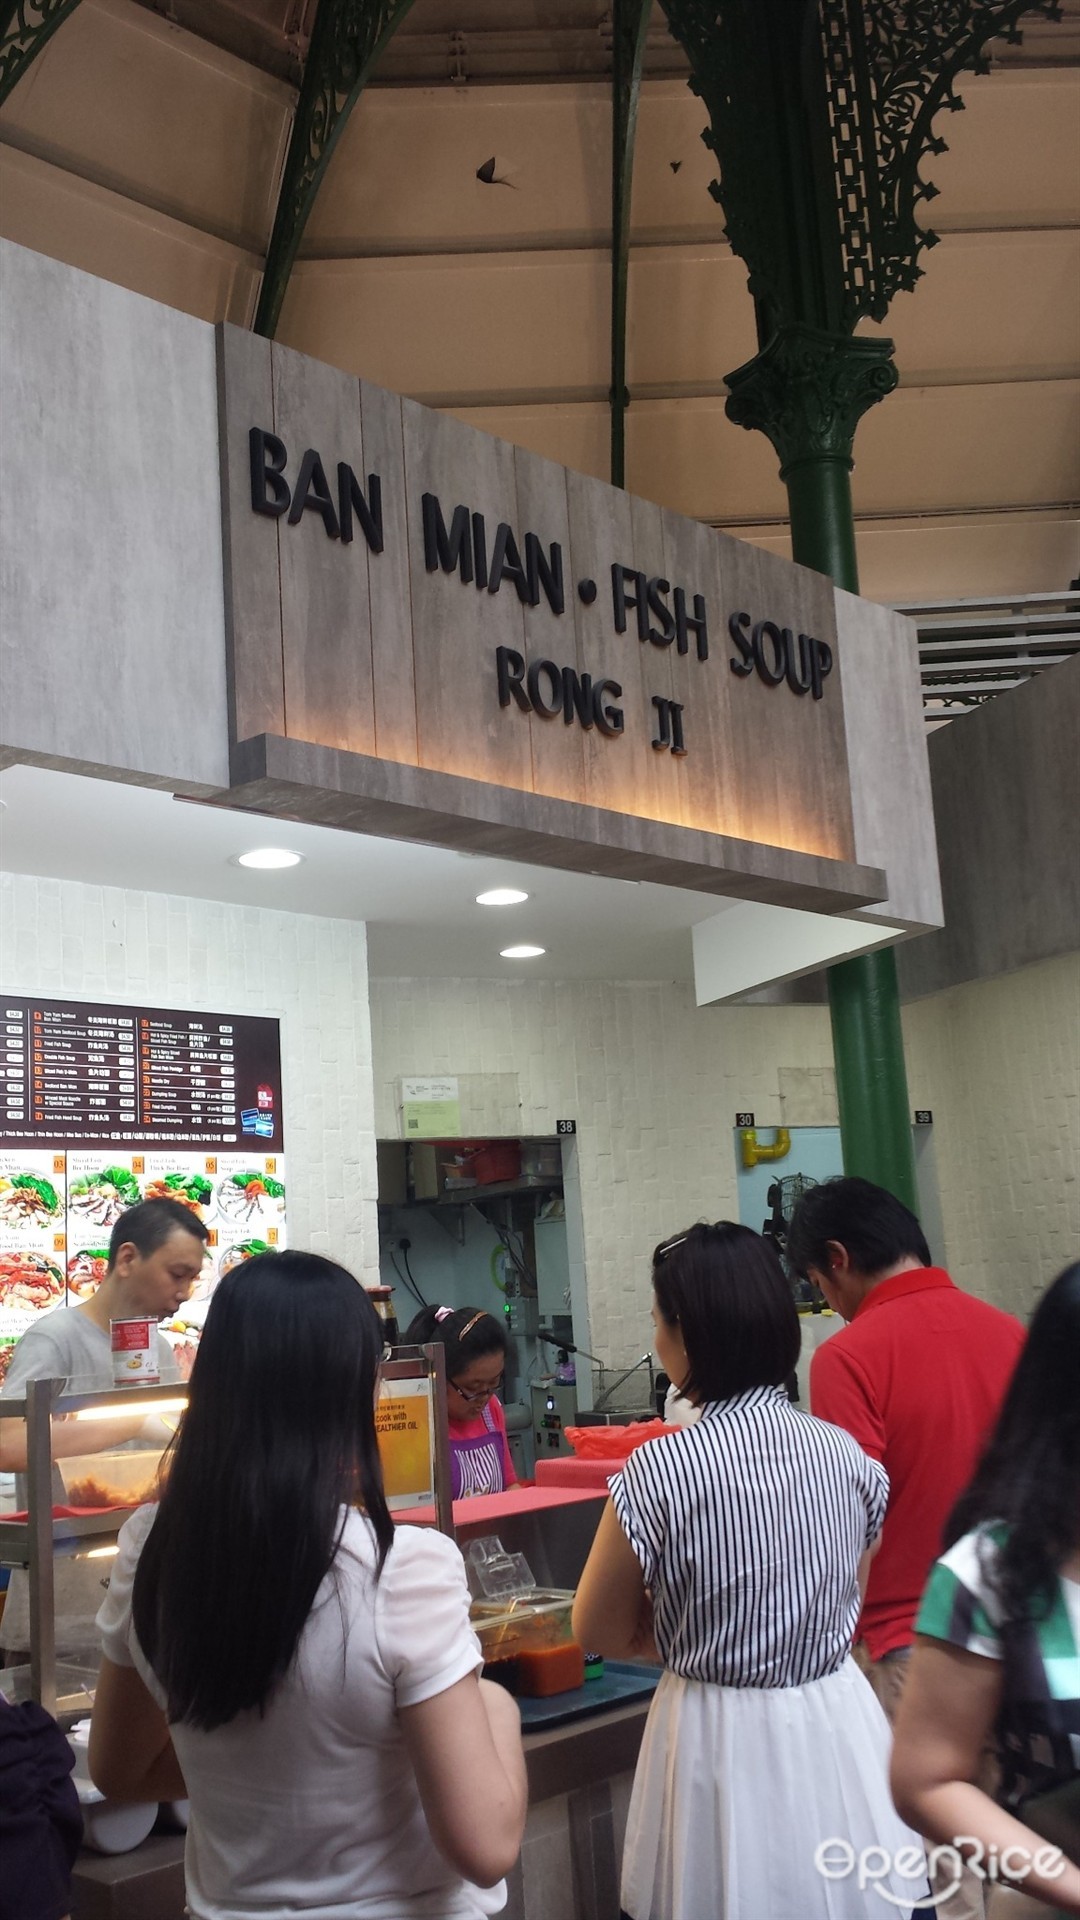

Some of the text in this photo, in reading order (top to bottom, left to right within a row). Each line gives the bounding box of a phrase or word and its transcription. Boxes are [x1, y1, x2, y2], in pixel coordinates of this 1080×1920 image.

[249, 427, 384, 553] BAN
[422, 492, 564, 615] MIAN
[611, 563, 708, 661] FISH
[728, 610, 832, 699] SOUP
[496, 645, 688, 756] RONG JI
[739, 1114, 751, 1126] 30
[918, 1112, 930, 1123] 39
[559, 1121, 573, 1133] 38
[53, 1160, 64, 1168] 03
[54, 1238, 64, 1246] 09
[393, 1412, 407, 1420] with
[376, 1421, 418, 1432] EALTHIER OIL
